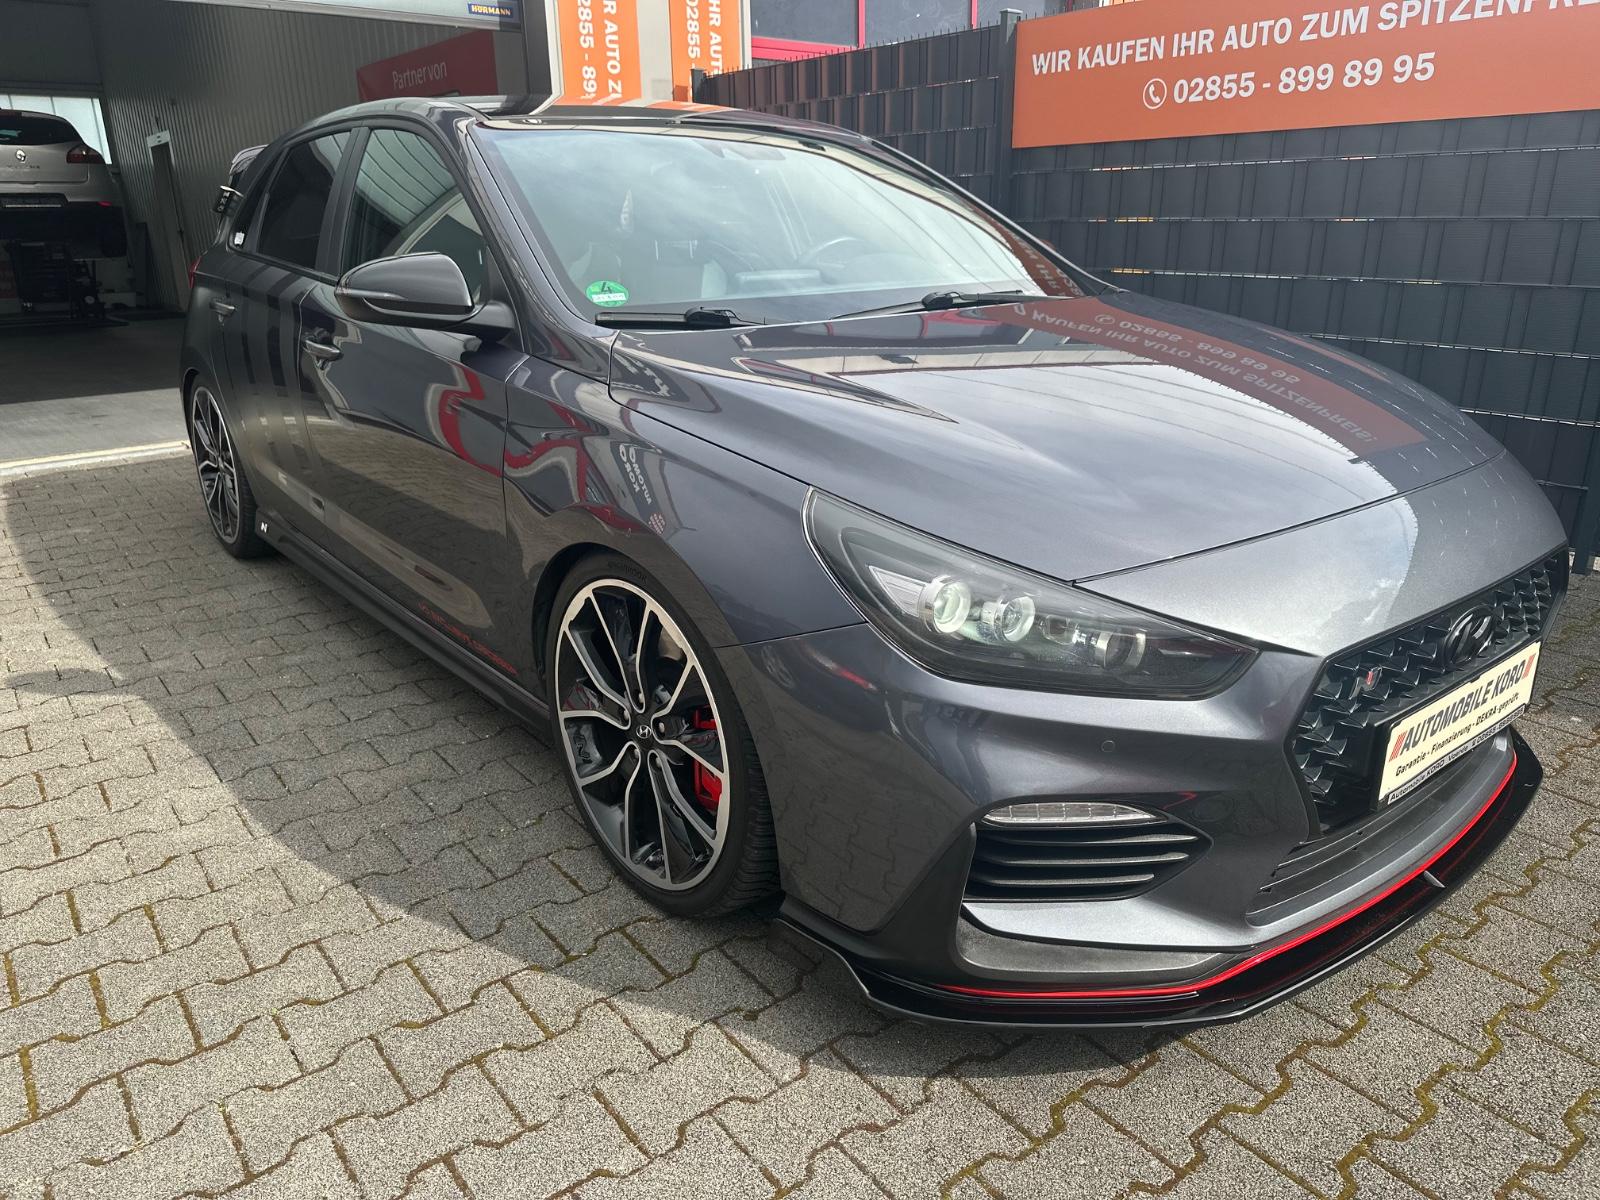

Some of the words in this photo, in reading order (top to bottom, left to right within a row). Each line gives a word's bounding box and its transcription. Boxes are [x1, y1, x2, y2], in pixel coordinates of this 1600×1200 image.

[604, 18, 621, 74] AUTO
[1031, 50, 1071, 76] WIR
[1077, 35, 1165, 70] KAUFEN
[1172, 28, 1215, 58] IHR
[1221, 17, 1293, 52] AUTO
[1299, 6, 1370, 41] ZUM
[392, 68, 427, 90] Partner
[427, 61, 448, 81] von
[580, 66, 598, 99] 89
[608, 79, 622, 98] Z
[1173, 72, 1255, 104] 02855
[1262, 80, 1271, 89] -
[1278, 62, 1334, 94] 899
[1342, 57, 1383, 88] 89
[1392, 51, 1436, 84] 95
[1400, 680, 1493, 756] AUTOMOBILE
[1491, 659, 1526, 700] KORO
[1395, 751, 1427, 776] Garantie
[1431, 724, 1472, 755] Finanzierung
